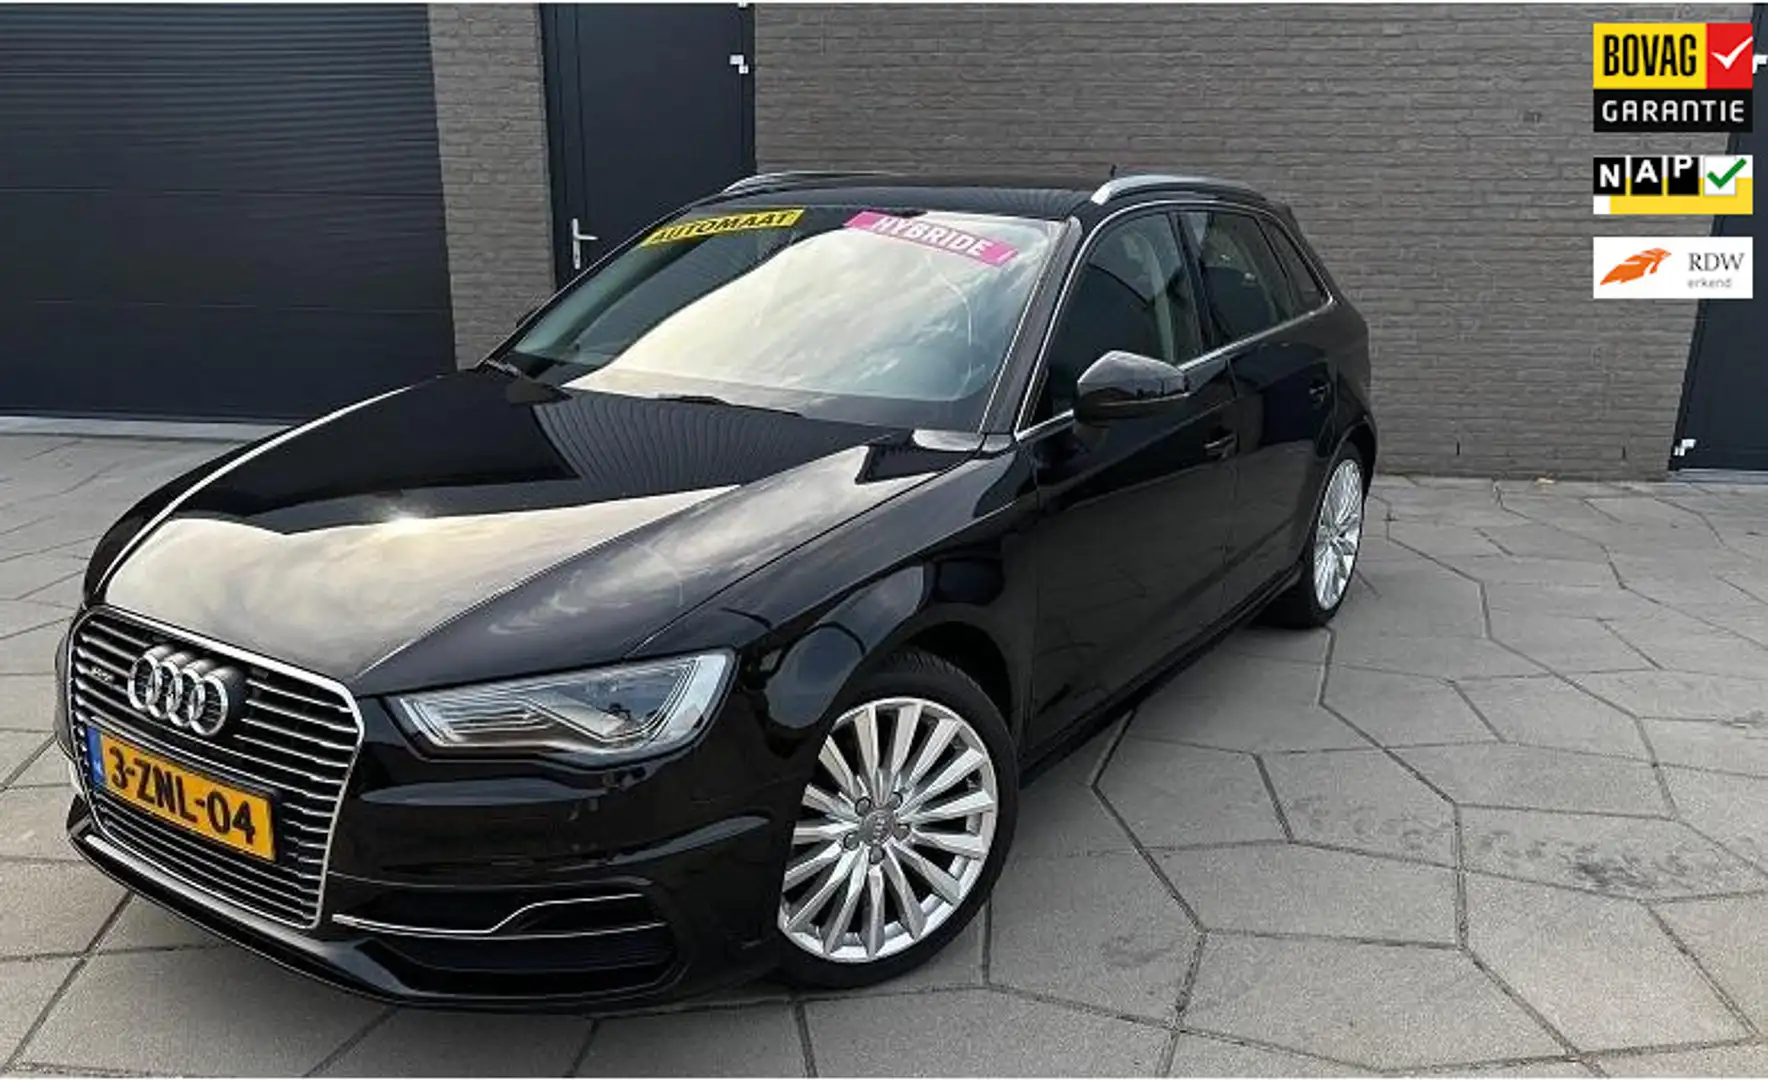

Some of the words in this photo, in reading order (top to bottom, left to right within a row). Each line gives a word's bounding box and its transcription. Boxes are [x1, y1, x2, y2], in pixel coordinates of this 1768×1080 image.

[651, 213, 788, 242] AUTOMAAT
[870, 215, 994, 255] HYBRIDE
[109, 746, 256, 845] 3-ZNL-04
